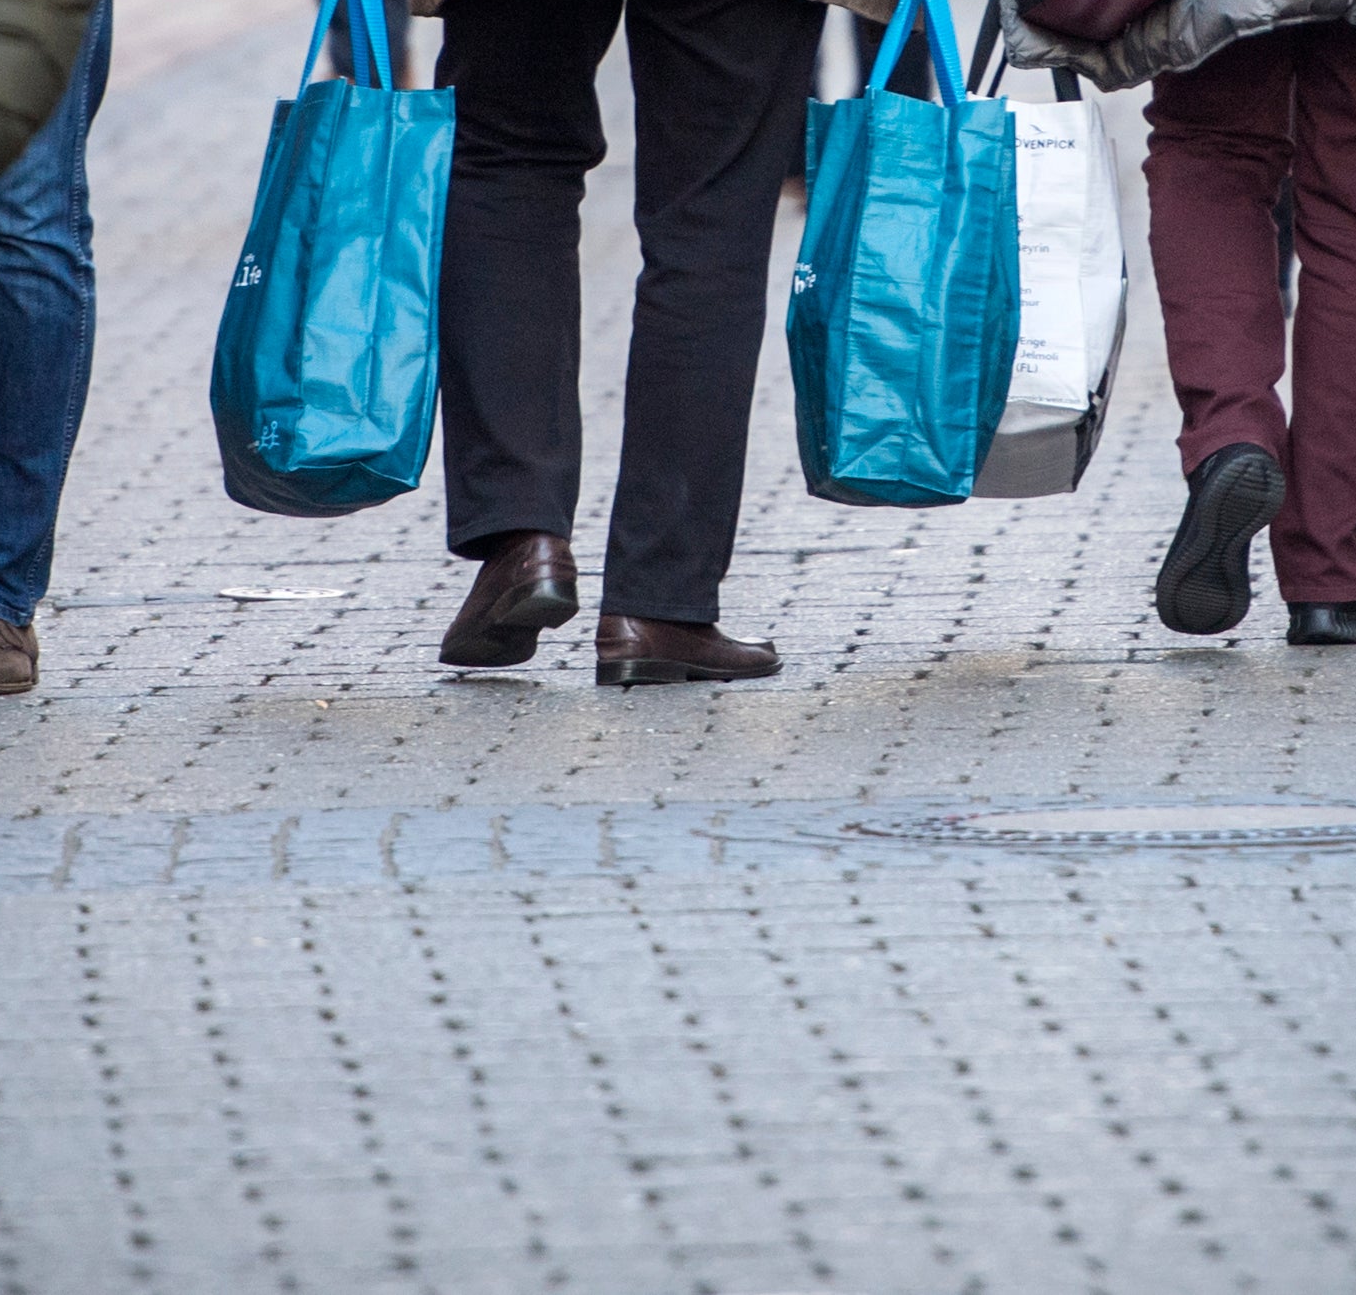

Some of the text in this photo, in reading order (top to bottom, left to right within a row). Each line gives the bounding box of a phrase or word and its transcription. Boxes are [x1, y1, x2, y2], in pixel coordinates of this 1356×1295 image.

[1019, 242, 1050, 255] eyrin
[1019, 336, 1046, 349] Enge
[1020, 349, 1059, 361] Jelmoli
[1016, 362, 1039, 374] (FL)
